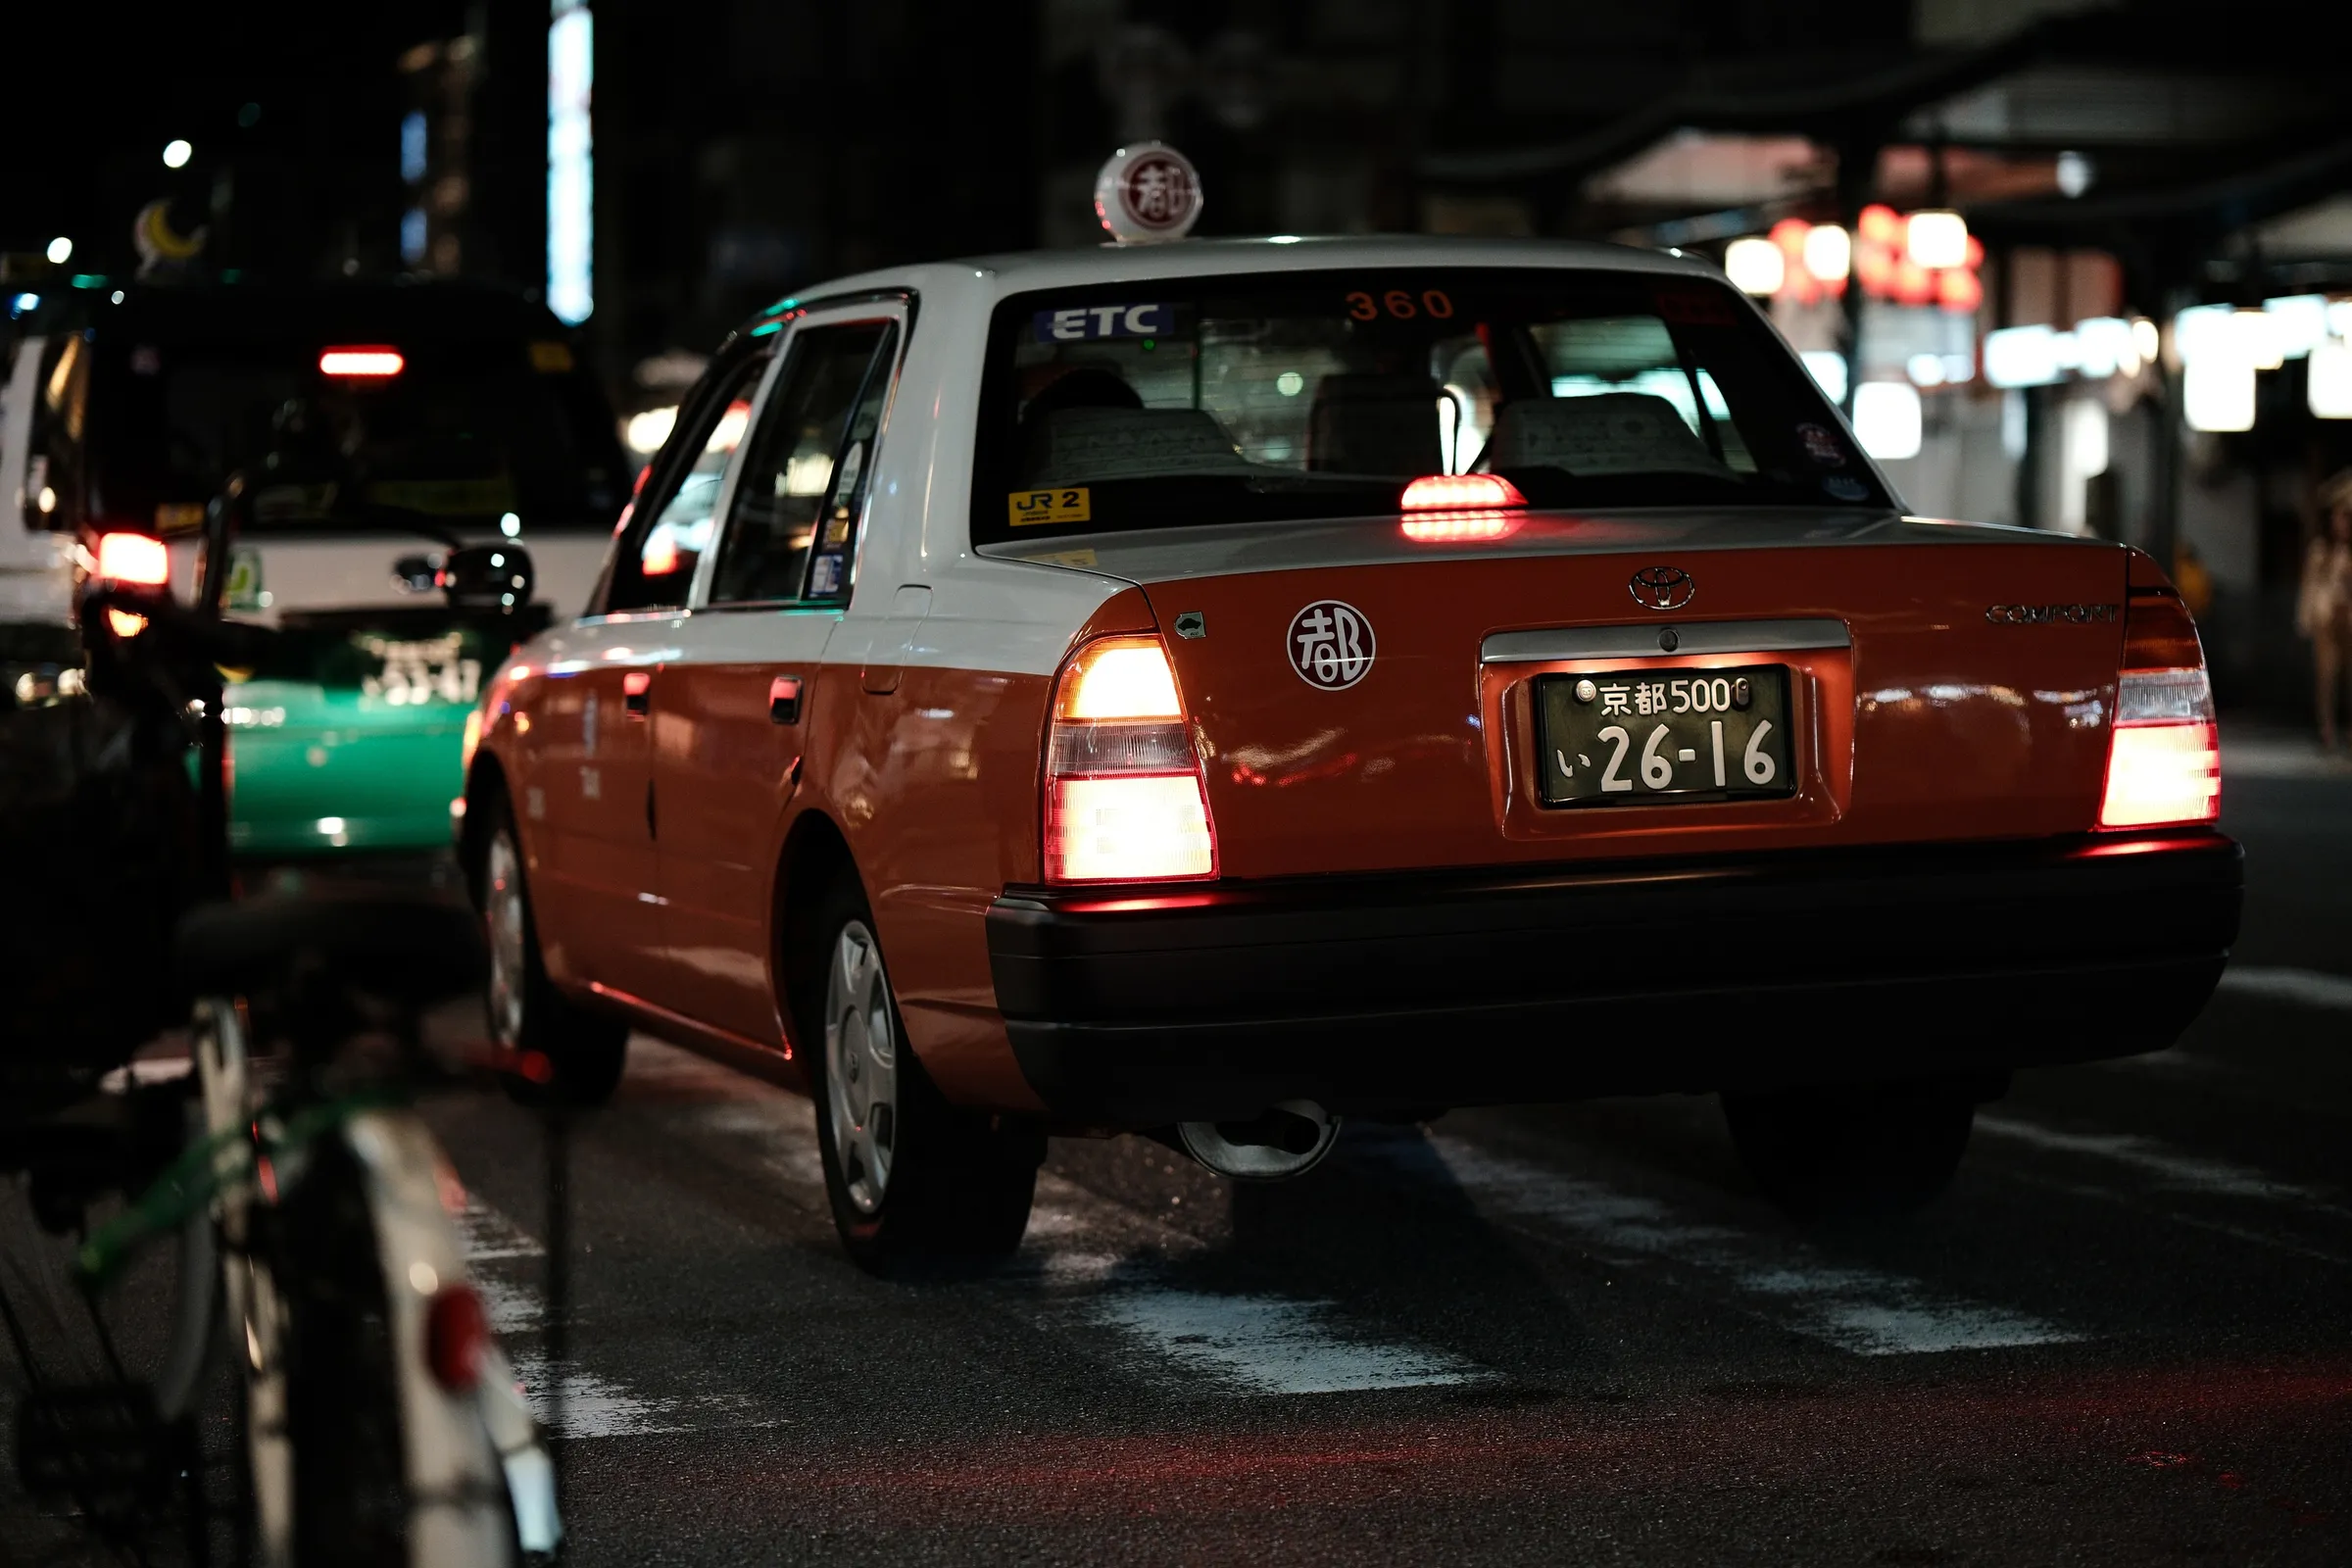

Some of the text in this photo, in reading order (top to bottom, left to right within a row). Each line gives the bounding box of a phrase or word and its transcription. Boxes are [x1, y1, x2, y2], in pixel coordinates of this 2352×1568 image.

[1051, 304, 1160, 339] ETC
[1345, 289, 1454, 321] 360
[1016, 491, 1080, 510] JR 2
[1985, 604, 2120, 624] COMFORT
[1297, 608, 1364, 683] 都
[1597, 719, 1776, 793] 26-16
